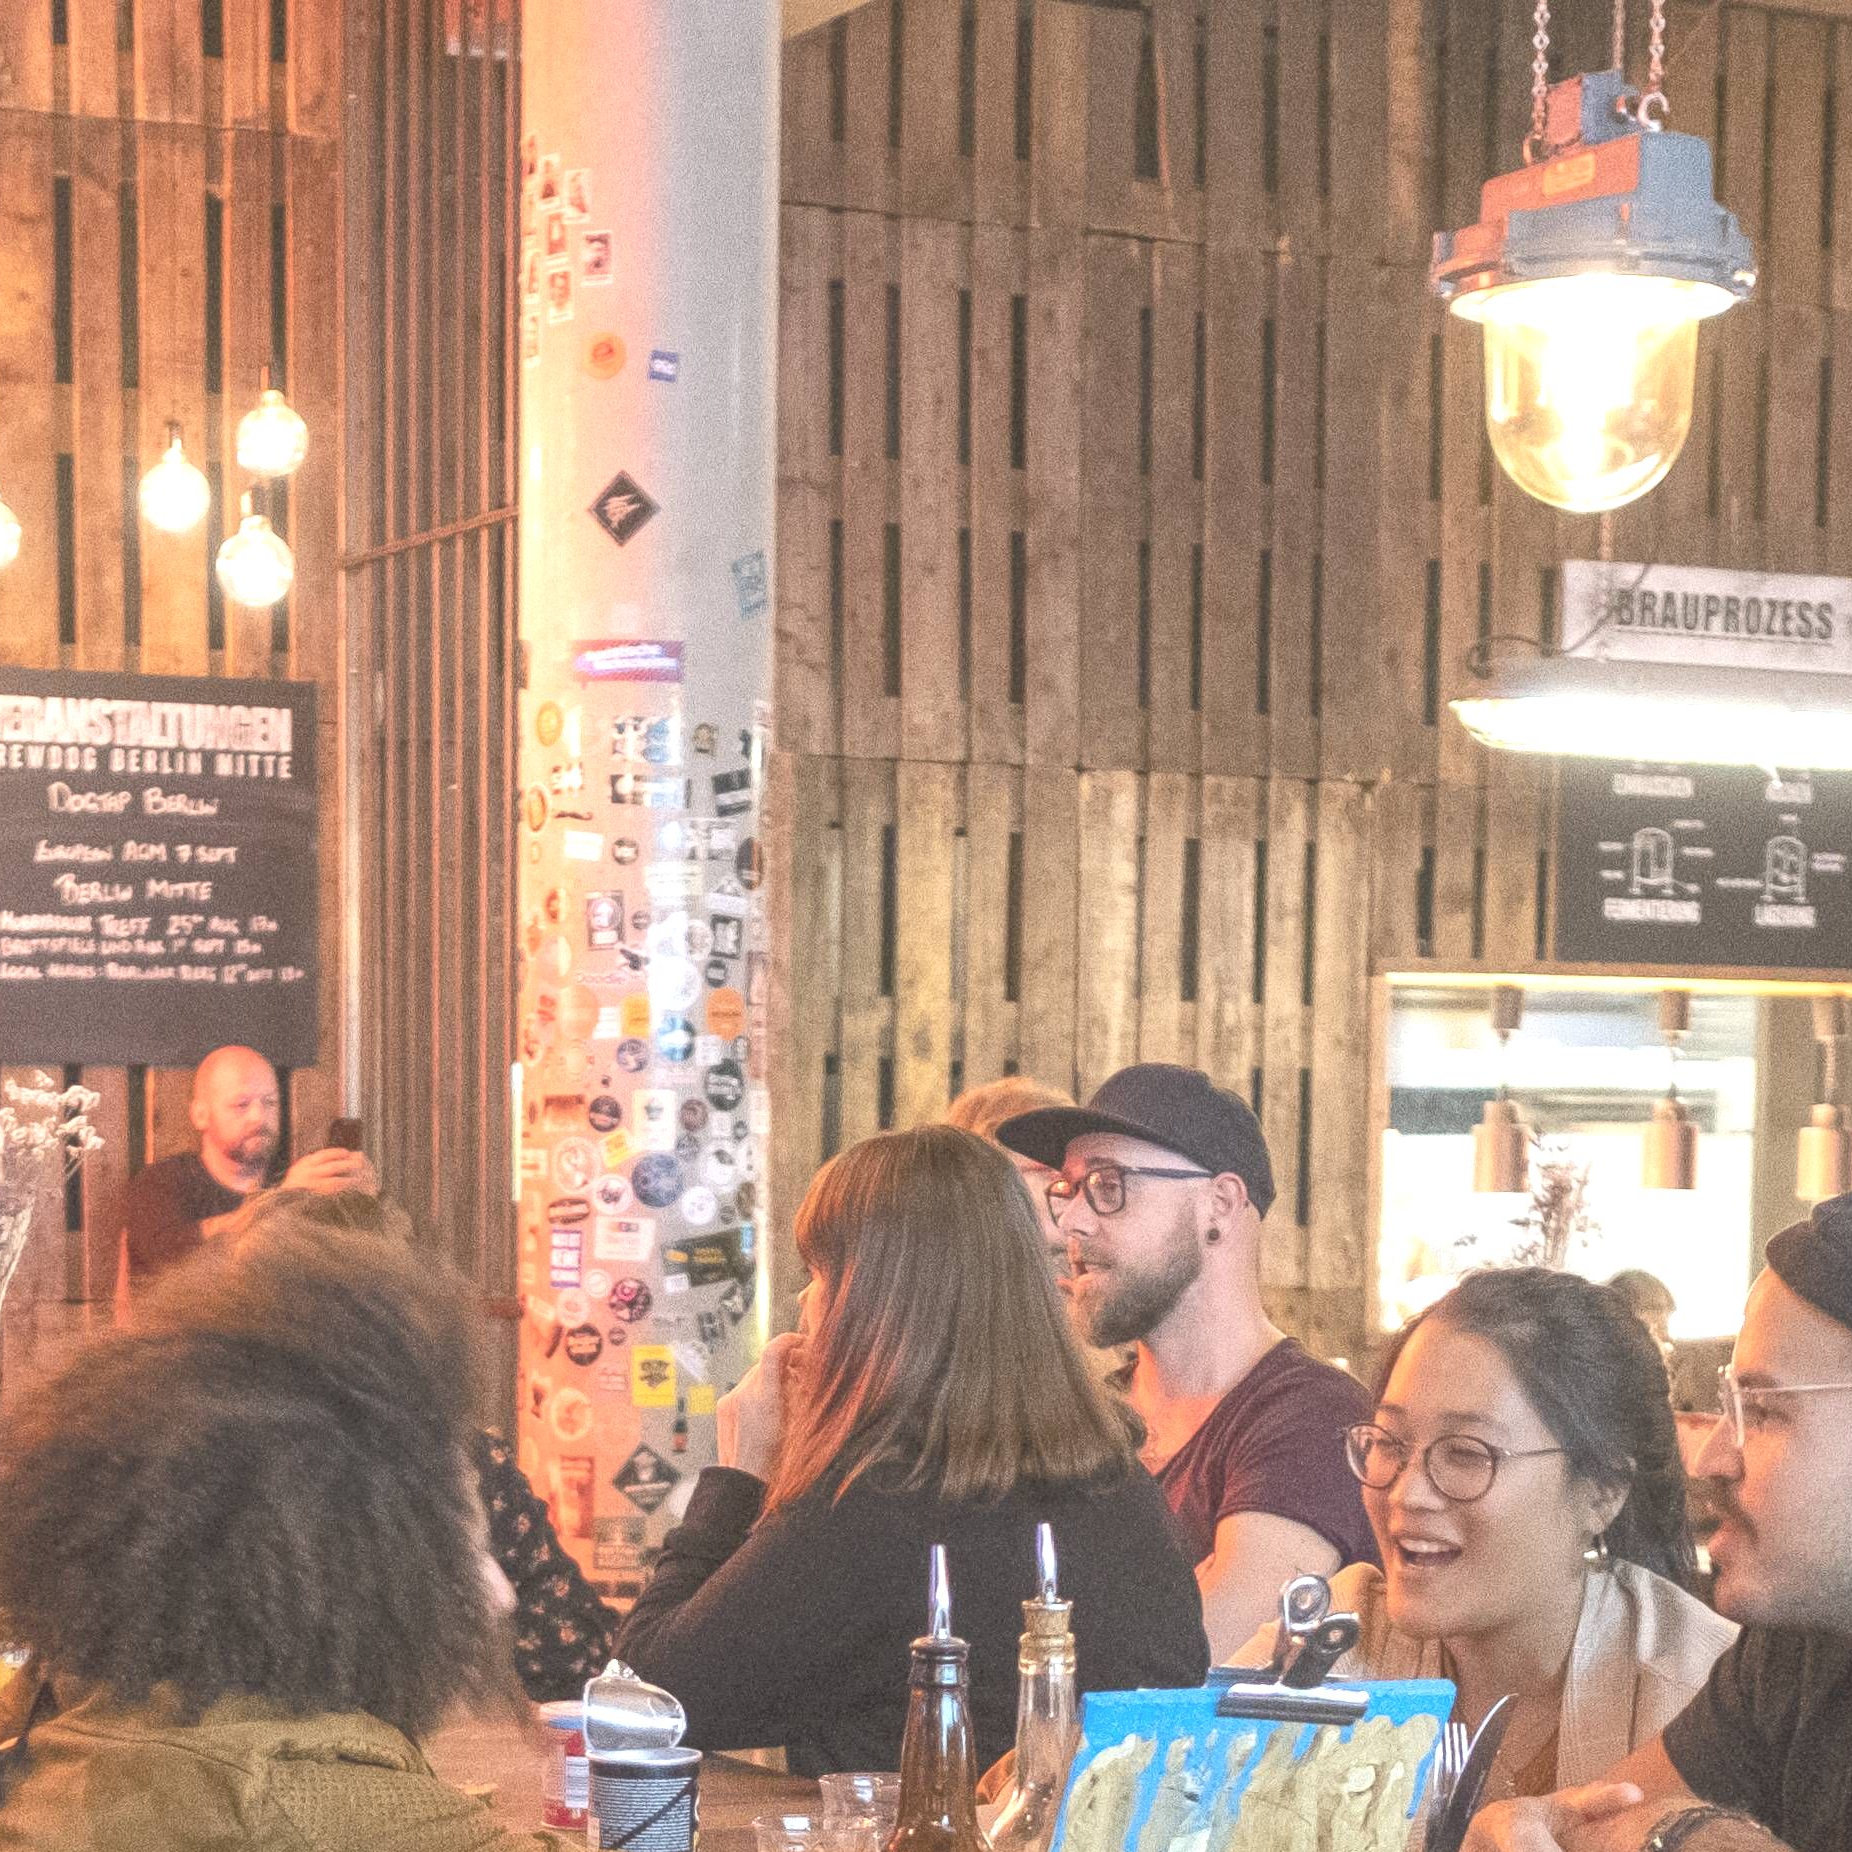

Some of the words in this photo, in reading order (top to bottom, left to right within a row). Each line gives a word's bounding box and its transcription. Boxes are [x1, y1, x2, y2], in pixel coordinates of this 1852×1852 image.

[1615, 589, 1835, 641] BRAUPROZESS
[109, 748, 203, 776] BERLIN
[214, 753, 294, 779] MITTE
